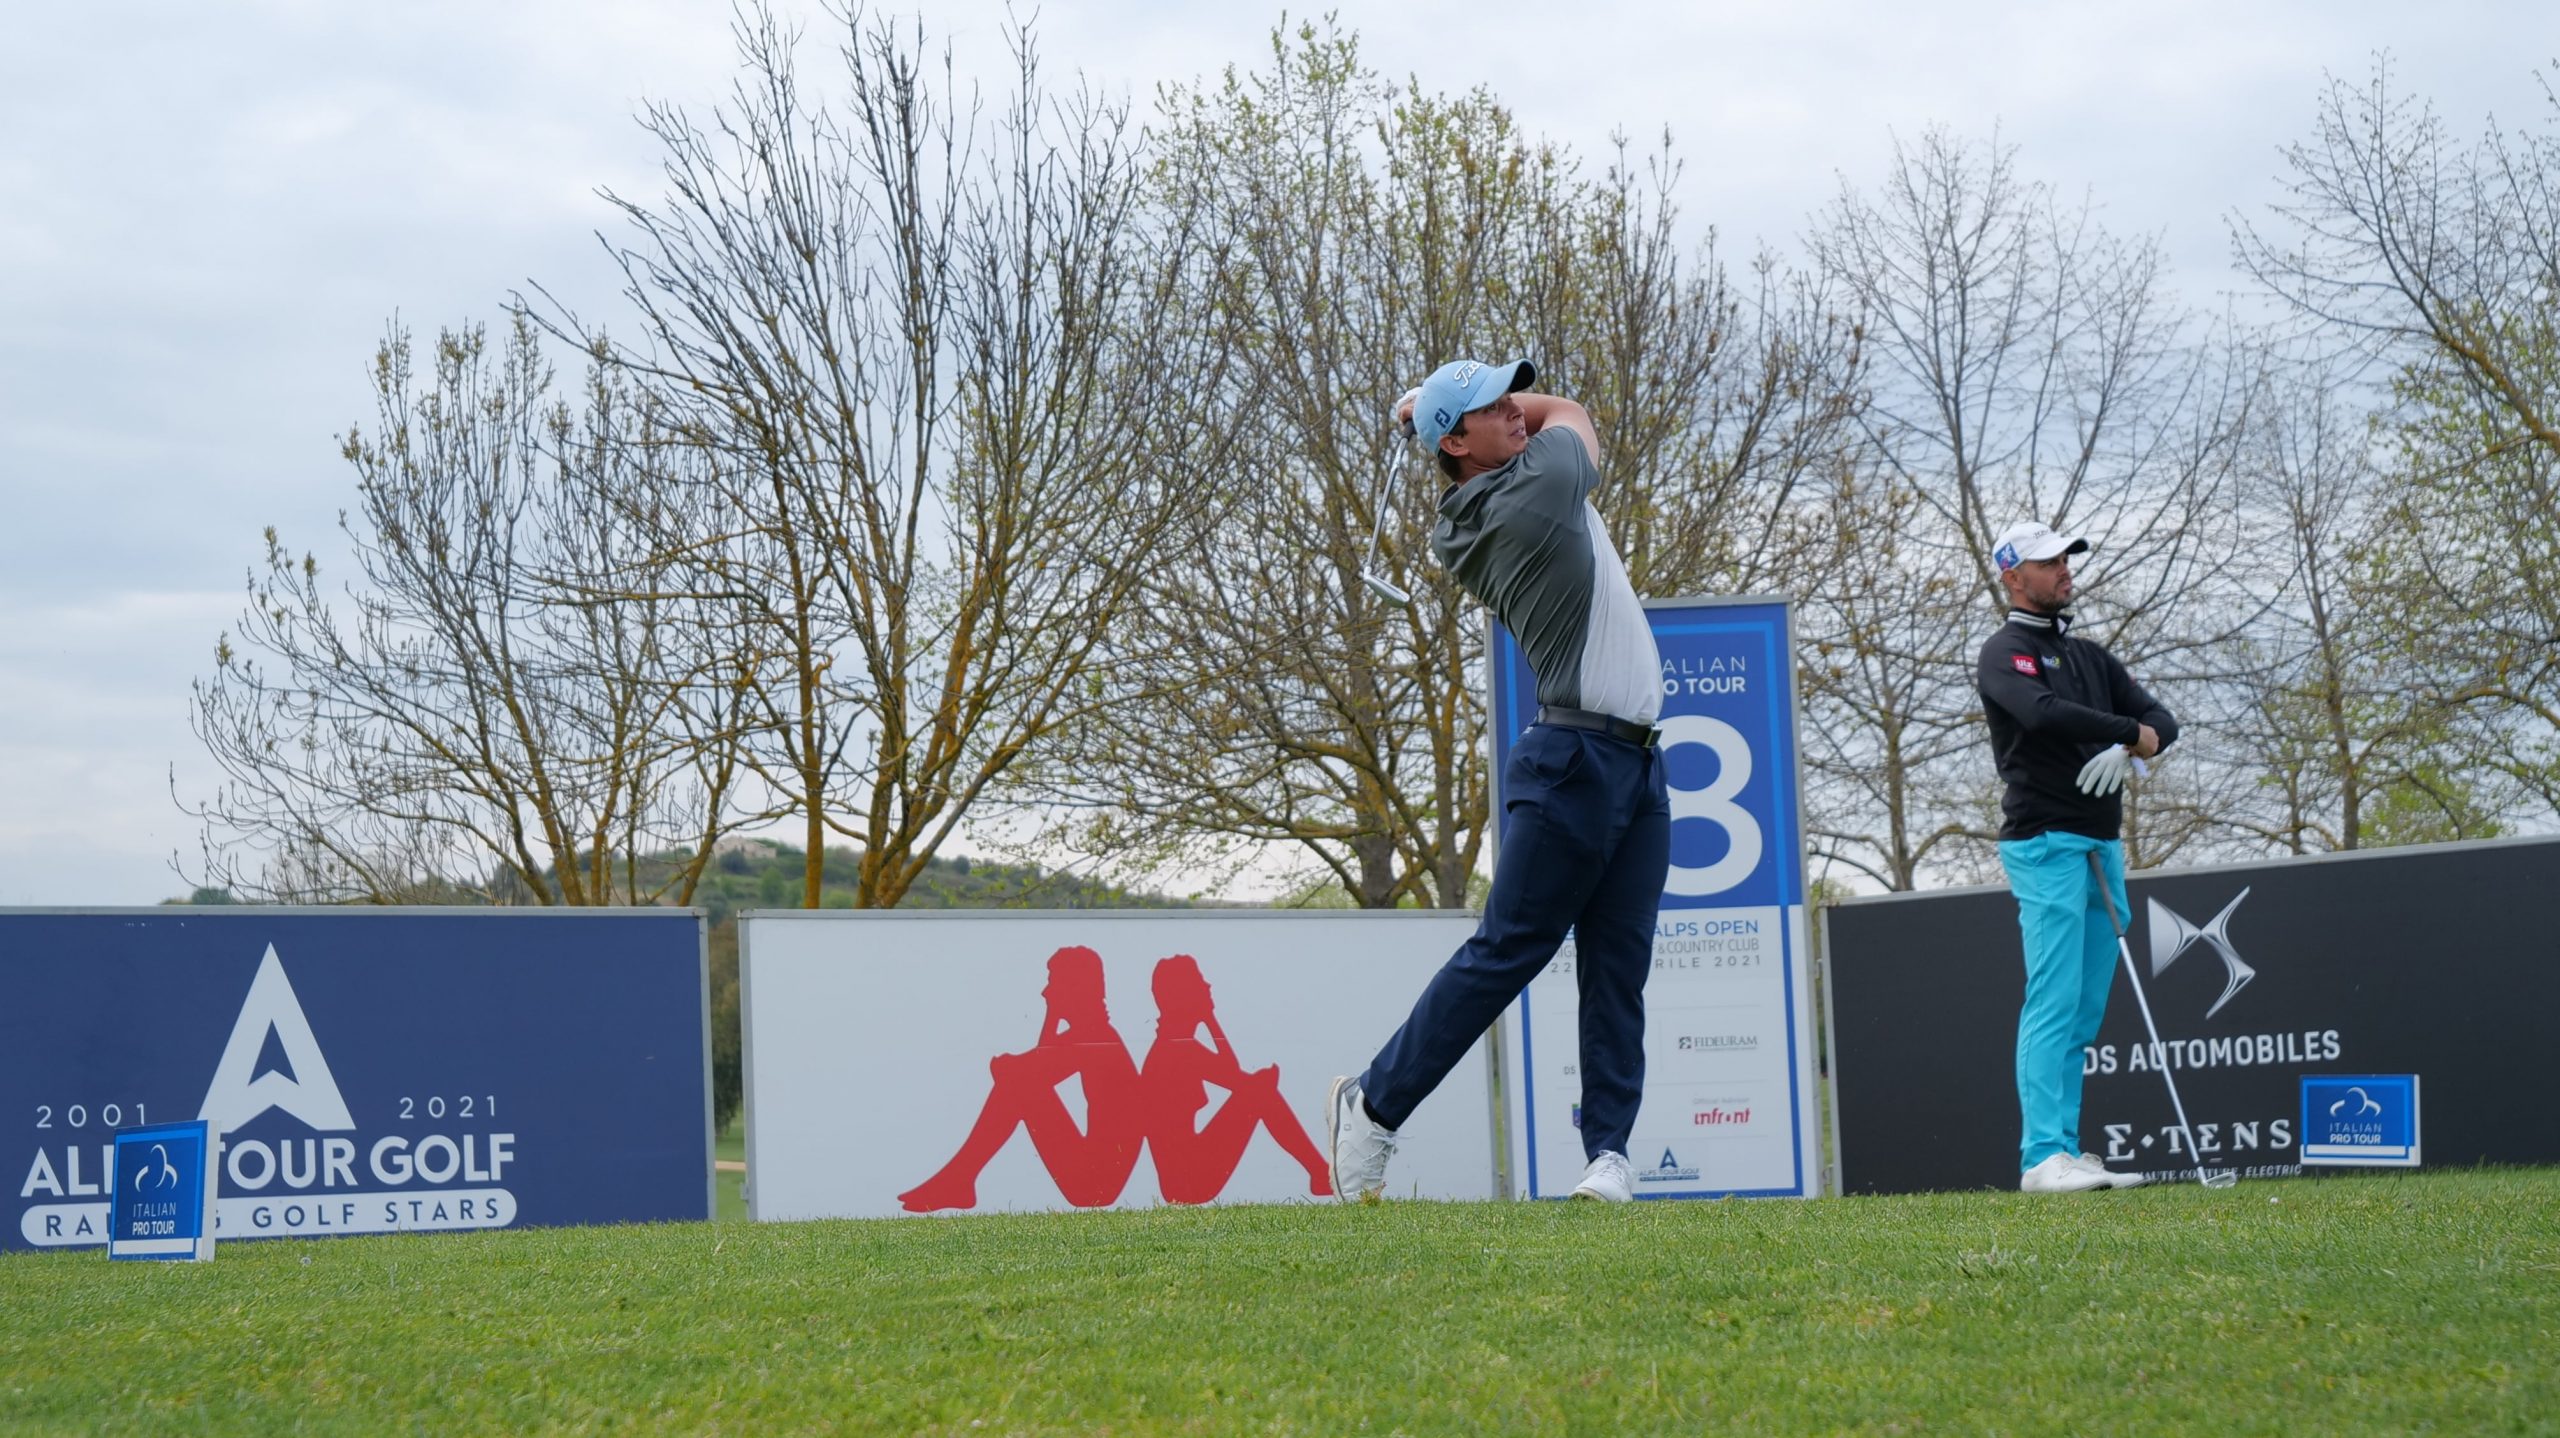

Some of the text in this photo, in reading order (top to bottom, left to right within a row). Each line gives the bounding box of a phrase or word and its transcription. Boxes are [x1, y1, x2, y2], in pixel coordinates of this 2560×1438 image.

[1662, 656, 1746, 674] ALIAN
[1685, 677, 1746, 694] TOUR
[1654, 919, 1759, 937] ALPS OPEN
[1666, 939, 1724, 954] COUNTRY
[1727, 937, 1760, 952] CLUB
[1655, 957, 1700, 969] RILE
[1714, 954, 1760, 967] 2021
[1694, 1035, 1757, 1047] FIDEURAM
[2082, 1029, 2341, 1075] DS AUTOMOBILES
[36, 1103, 145, 1128] 2001
[399, 1095, 496, 1119] 2021
[2329, 1123, 2382, 1133] ITALIAN
[2329, 1133, 2382, 1144] PRO TOUR
[20, 1133, 515, 1197] AL OUR GOLF
[2245, 1163, 2302, 1177] ELECTRIC
[133, 1202, 177, 1217] ITALIAN
[252, 1198, 499, 1228] GOLF STARS
[132, 1220, 175, 1236] PRO TOUR
